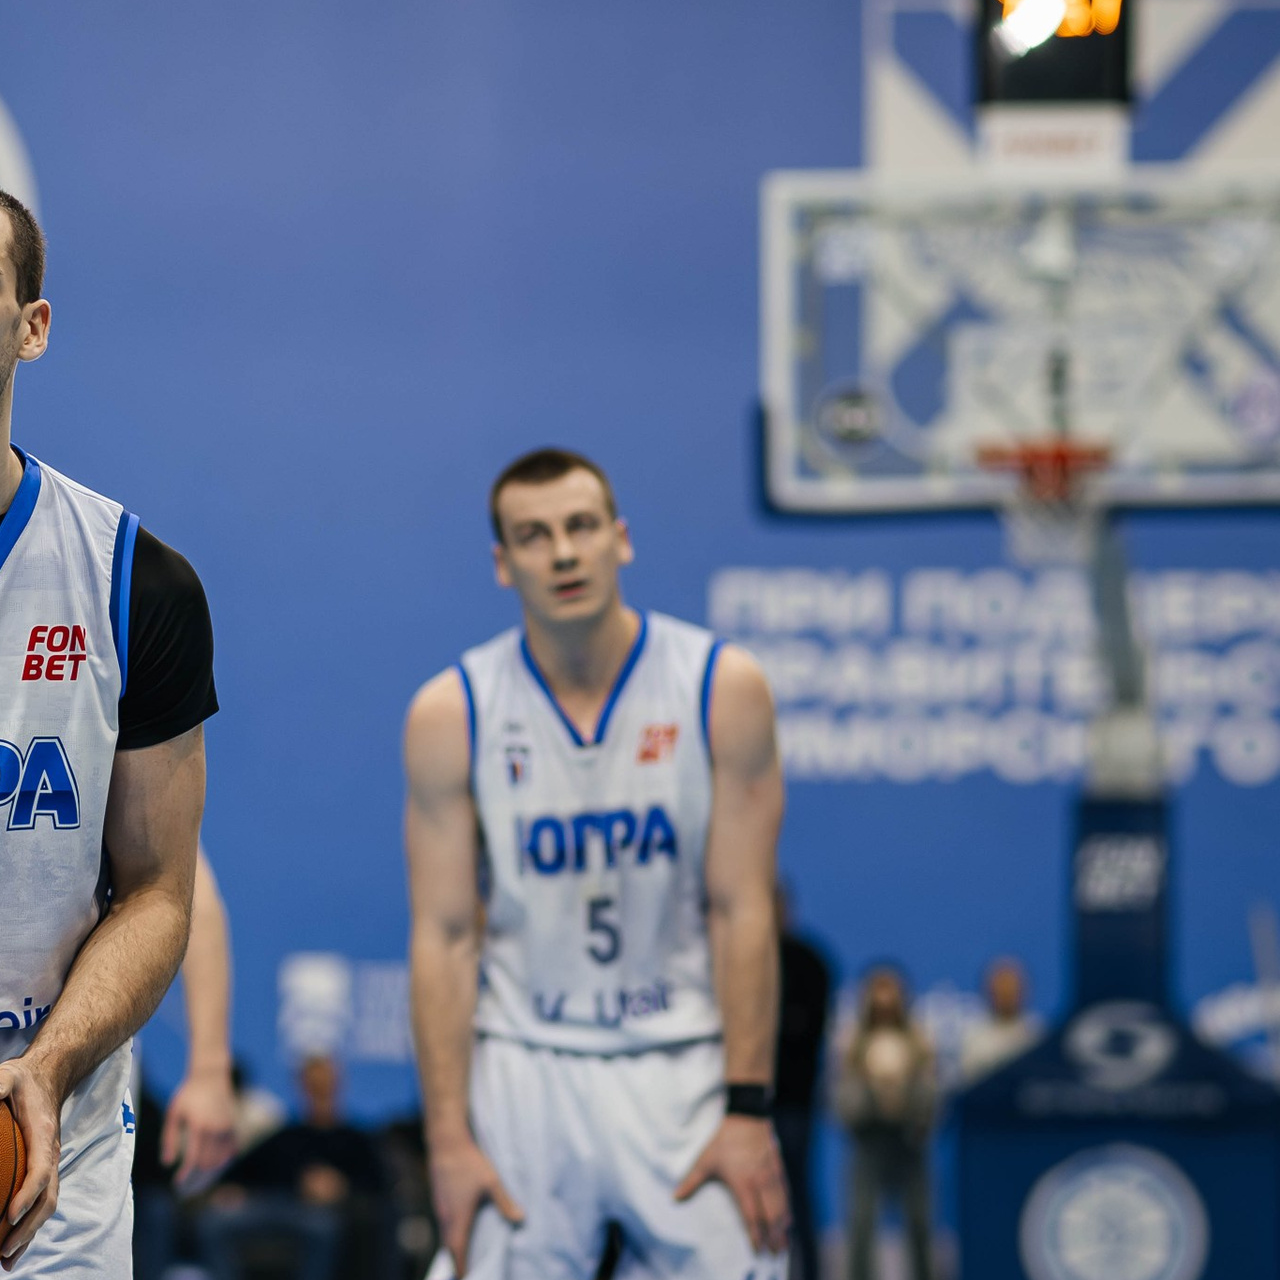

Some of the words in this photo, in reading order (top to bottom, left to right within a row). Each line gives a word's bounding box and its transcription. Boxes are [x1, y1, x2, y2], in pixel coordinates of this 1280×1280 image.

[28, 625, 86, 652] FON
[22, 654, 86, 681] BET
[586, 897, 624, 966] 5
